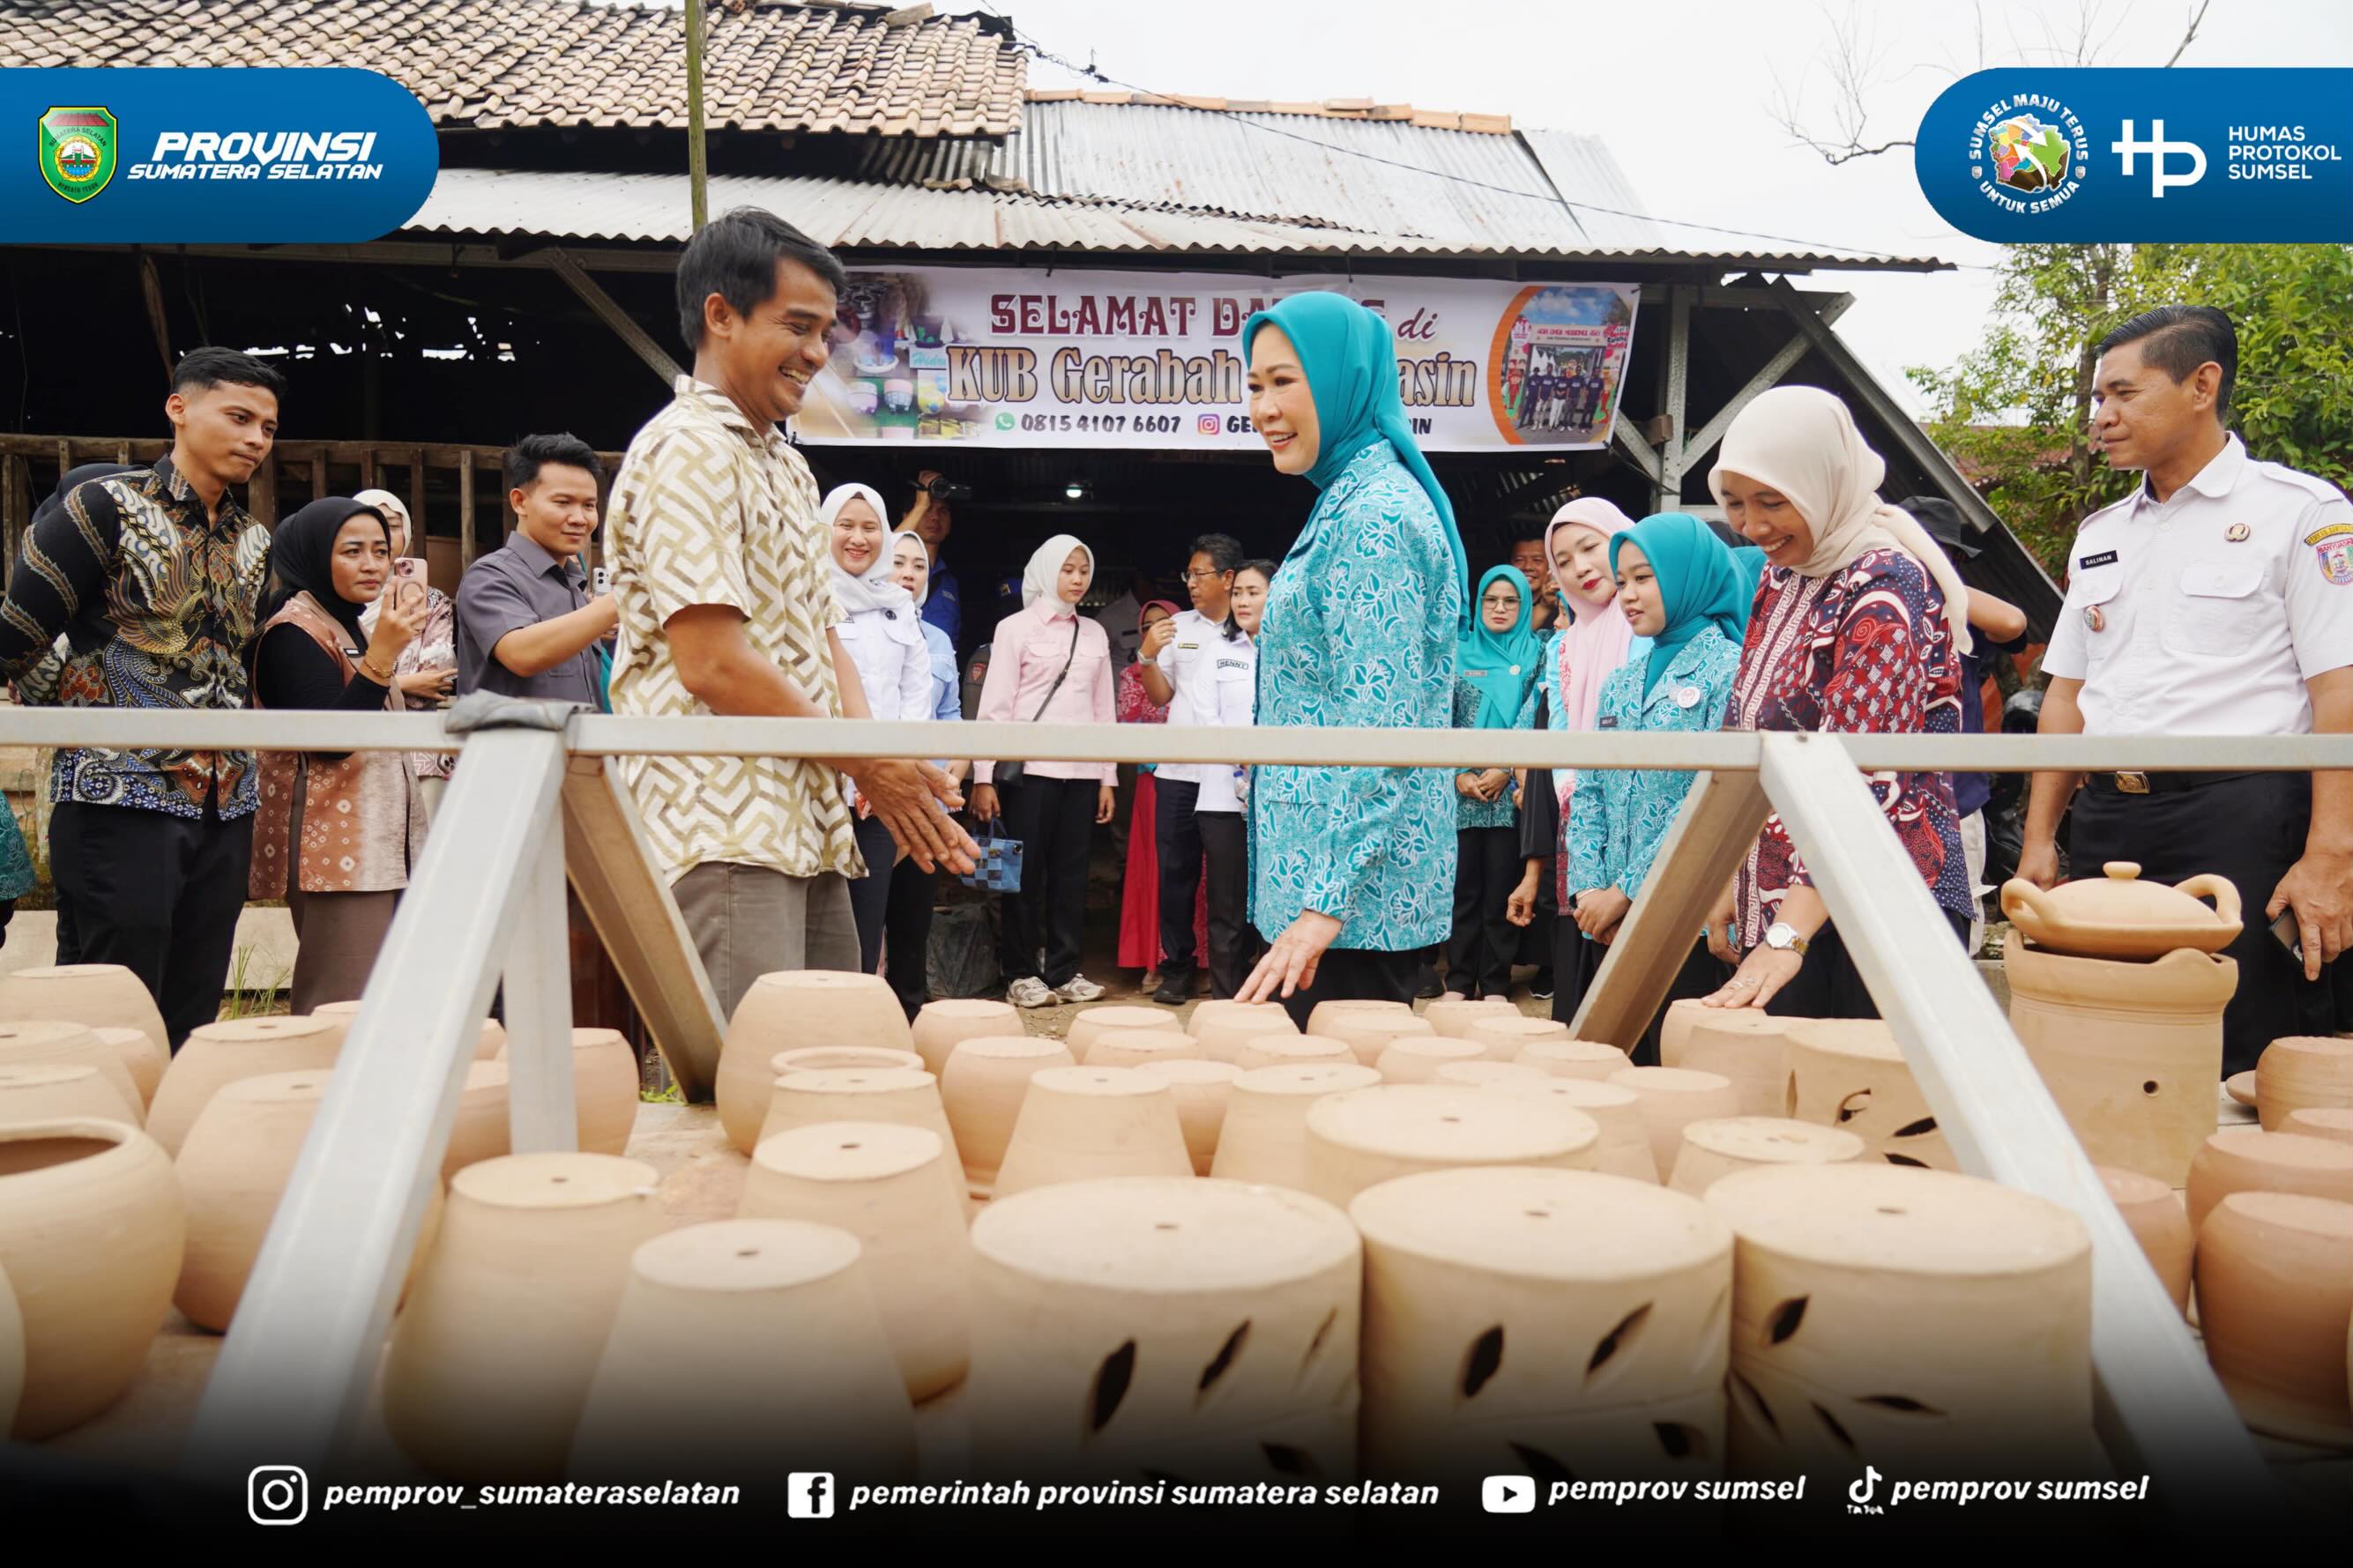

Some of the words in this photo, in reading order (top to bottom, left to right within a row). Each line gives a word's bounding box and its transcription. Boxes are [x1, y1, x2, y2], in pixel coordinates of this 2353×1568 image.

[991, 294, 1196, 336] SELAMAT
[1397, 308, 1439, 339] di
[945, 346, 1039, 404] KUB
[1051, 347, 1242, 405] Gerabah
[1021, 413, 1072, 432] 0815
[1076, 415, 1127, 433] 4107
[1133, 415, 1182, 434] 6607
